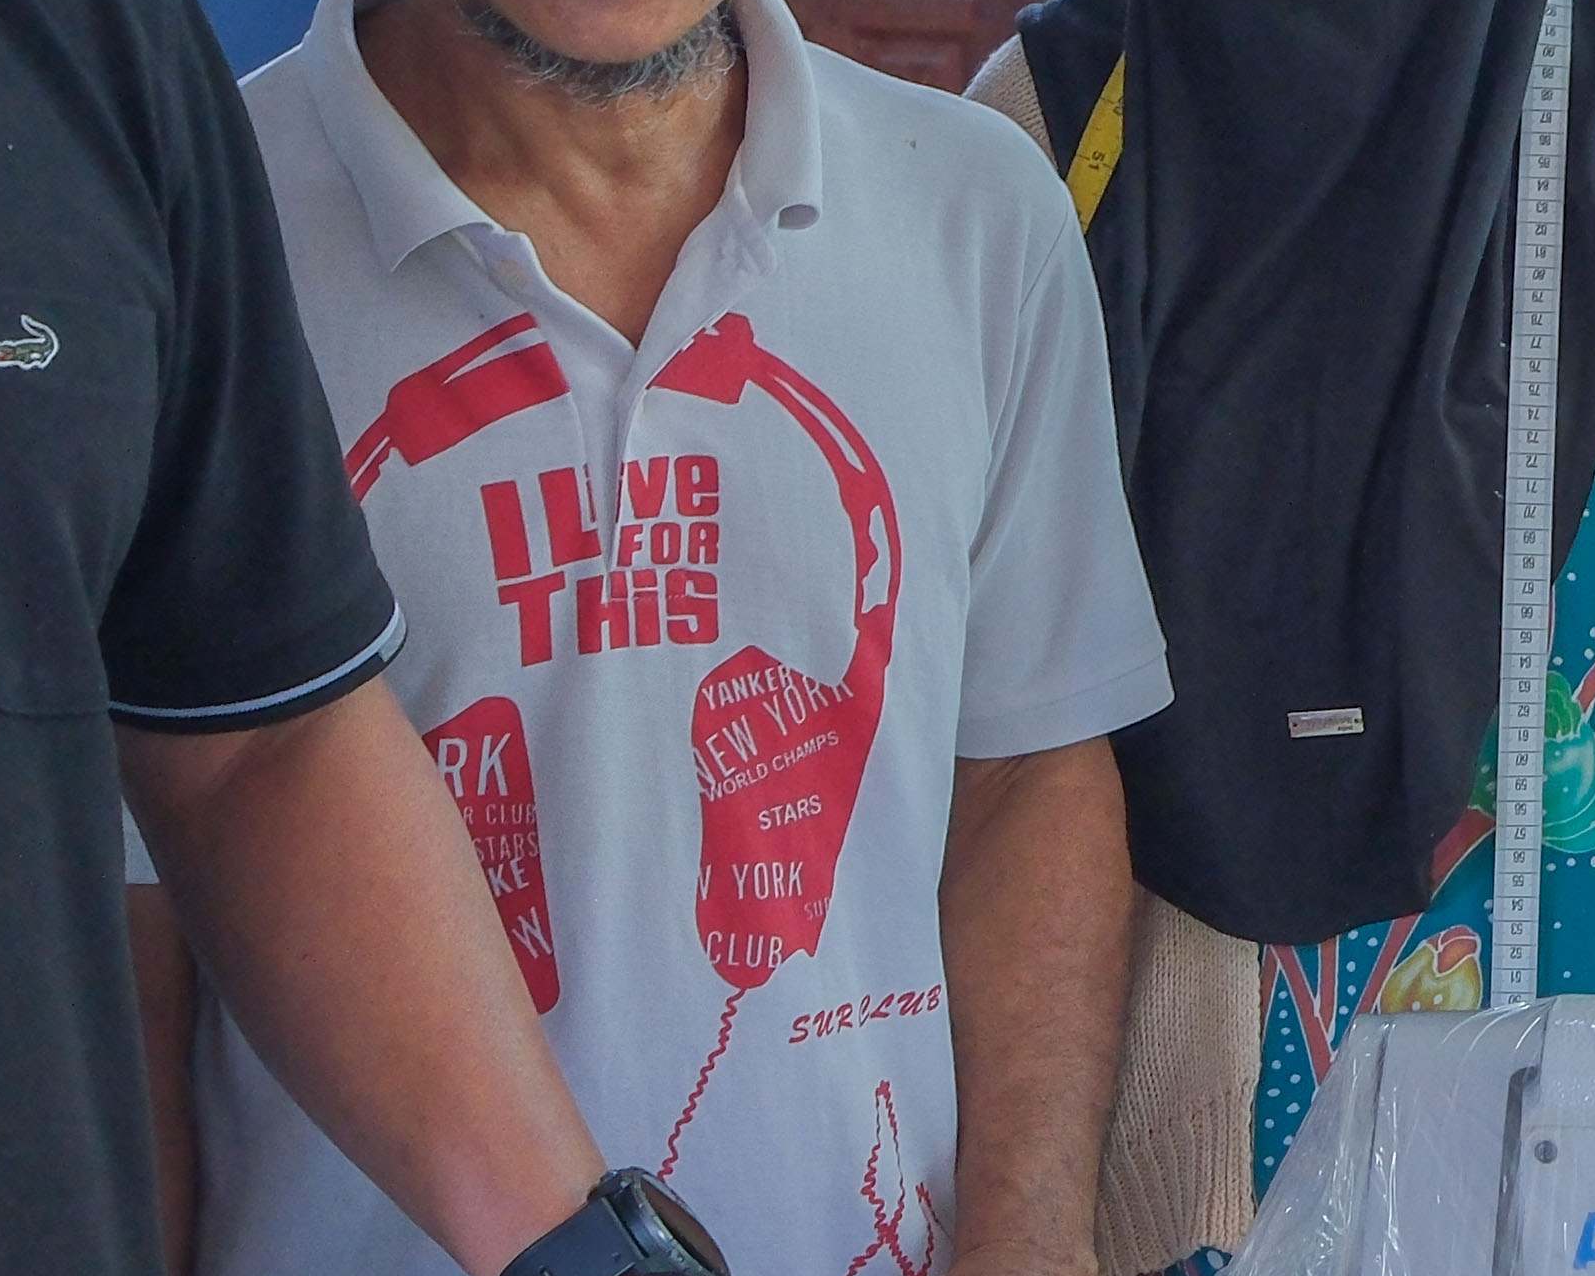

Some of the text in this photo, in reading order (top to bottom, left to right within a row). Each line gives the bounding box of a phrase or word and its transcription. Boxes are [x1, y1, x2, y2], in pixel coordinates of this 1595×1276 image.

[1545, 26, 1555, 37] 91
[1542, 46, 1554, 58] 90
[1542, 67, 1554, 79] 89
[1541, 89, 1553, 101] 88
[1540, 112, 1552, 124] 87
[1539, 135, 1551, 146] 86
[1538, 157, 1550, 168] 85
[1537, 179, 1549, 191] 84
[1536, 202, 1548, 213] 83
[1535, 224, 1547, 236] 82
[1535, 246, 1546, 258] 81
[1532, 269, 1546, 280] 80
[1532, 291, 1544, 303] 79
[1531, 314, 1543, 326] 78
[1530, 337, 1542, 348] 77
[1529, 360, 1541, 372] 76
[1528, 384, 1540, 396] 75
[1527, 408, 1540, 420] 74
[1526, 431, 1539, 443] 73
[1525, 455, 1538, 468] 72
[1526, 481, 1537, 493] 71
[1523, 506, 1536, 518] 70
[480, 479, 532, 581] I
[1523, 531, 1535, 544] 69
[617, 521, 719, 567] FOR
[1522, 556, 1535, 569] 68
[1521, 582, 1534, 594] 67
[1520, 606, 1533, 619] 66
[1520, 631, 1532, 643] 65
[1519, 656, 1532, 668] 64
[1518, 680, 1531, 693] 63
[1517, 705, 1530, 717] 62
[1518, 729, 1529, 742] 61
[693, 714, 757, 790] NEW
[701, 730, 839, 802] WORLD CHAMPS
[1515, 754, 1528, 766] 60
[1515, 778, 1527, 790] 59
[758, 794, 822, 830] STARS
[1514, 803, 1527, 815] 58
[1514, 827, 1526, 839] 57
[1513, 851, 1525, 863] 56
[732, 860, 804, 901] YORK
[1512, 874, 1524, 887] 55
[1511, 898, 1524, 911] 54
[1510, 922, 1523, 935] 53
[707, 930, 783, 970] CLUB
[1509, 946, 1522, 959] 52
[1510, 971, 1521, 983] 51
